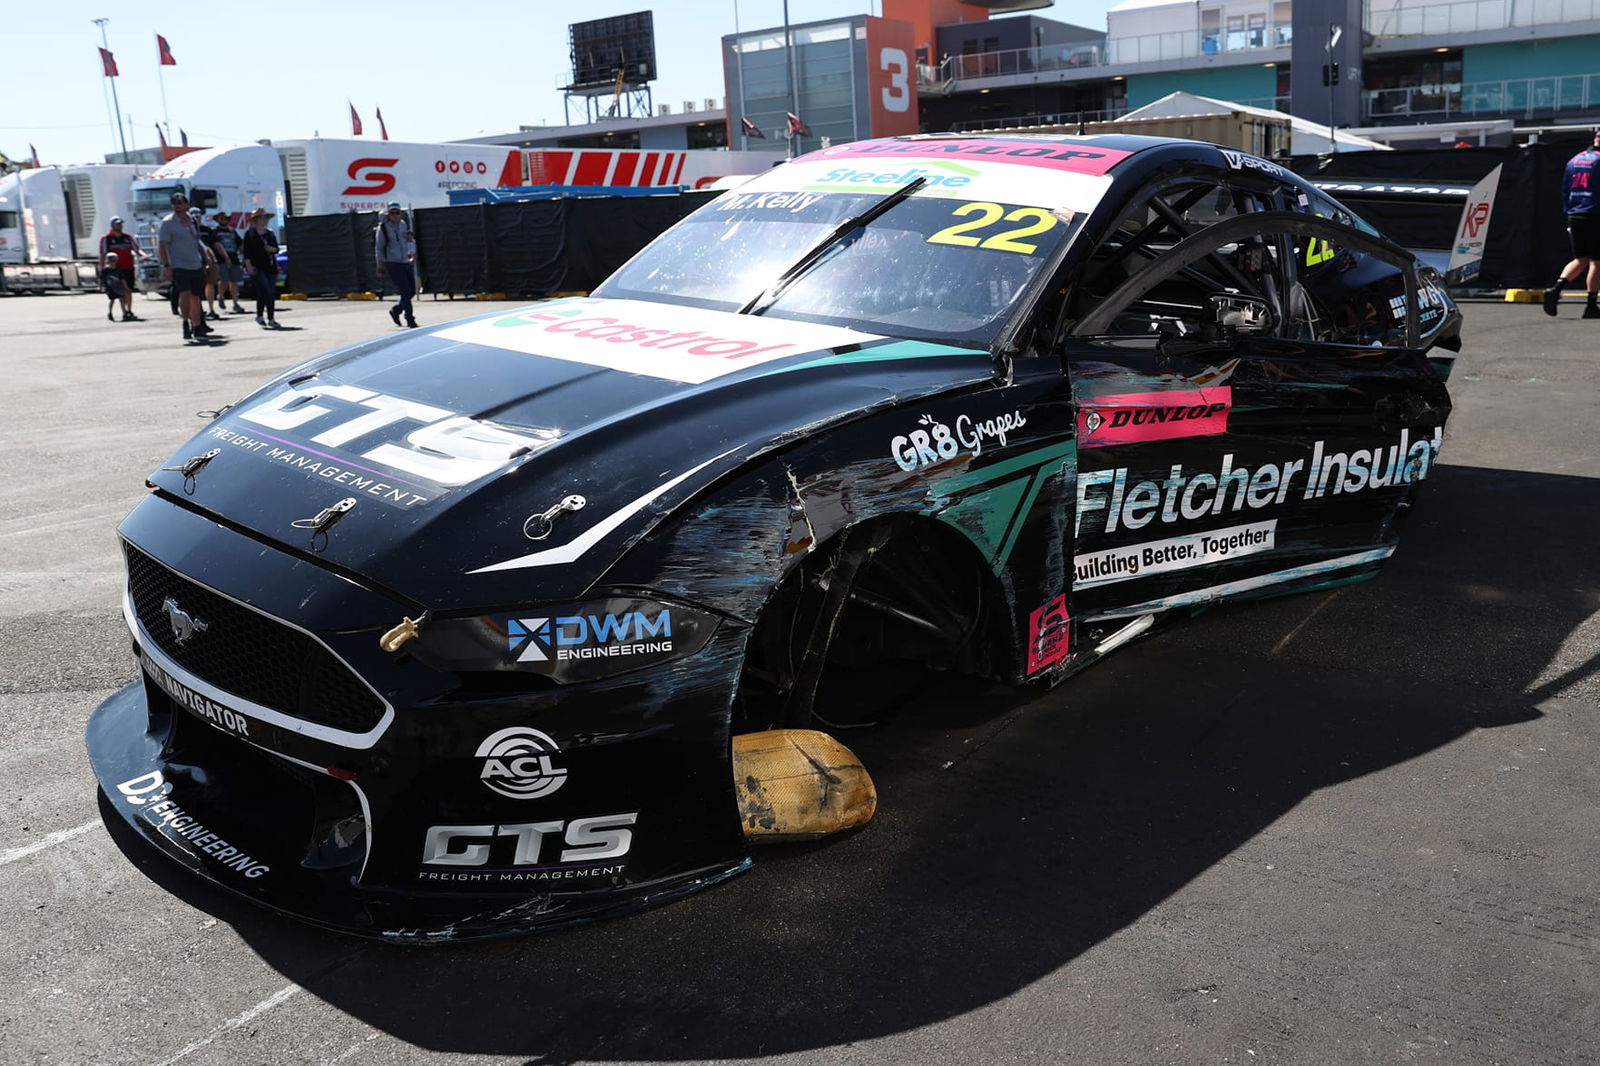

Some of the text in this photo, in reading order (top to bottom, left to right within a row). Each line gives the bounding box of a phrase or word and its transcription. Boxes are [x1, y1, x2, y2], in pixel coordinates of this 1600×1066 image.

[880, 47, 910, 113] 3
[852, 143, 1106, 161] DUNLOP
[815, 167, 972, 188] Steeline
[926, 201, 1058, 255] 22
[543, 317, 798, 360] Castrol
[239, 384, 567, 488] GTS
[1109, 402, 1226, 428] DUNLOP
[891, 410, 1027, 472] GR8 Grapes
[207, 426, 428, 507] FREIGHT MANAGEMENT
[1074, 453, 1304, 539] Fletcher
[1142, 540, 1197, 567] Better,
[1201, 527, 1270, 556] Together
[556, 608, 673, 646] DWM
[556, 640, 673, 660] ENGINEERING
[164, 673, 250, 737] NAVIGATOR
[480, 755, 568, 779] ACL
[151, 799, 271, 879] ENGINEERING
[422, 812, 639, 866] GTS
[419, 864, 625, 881] FREIGHT MANAGEMENT
